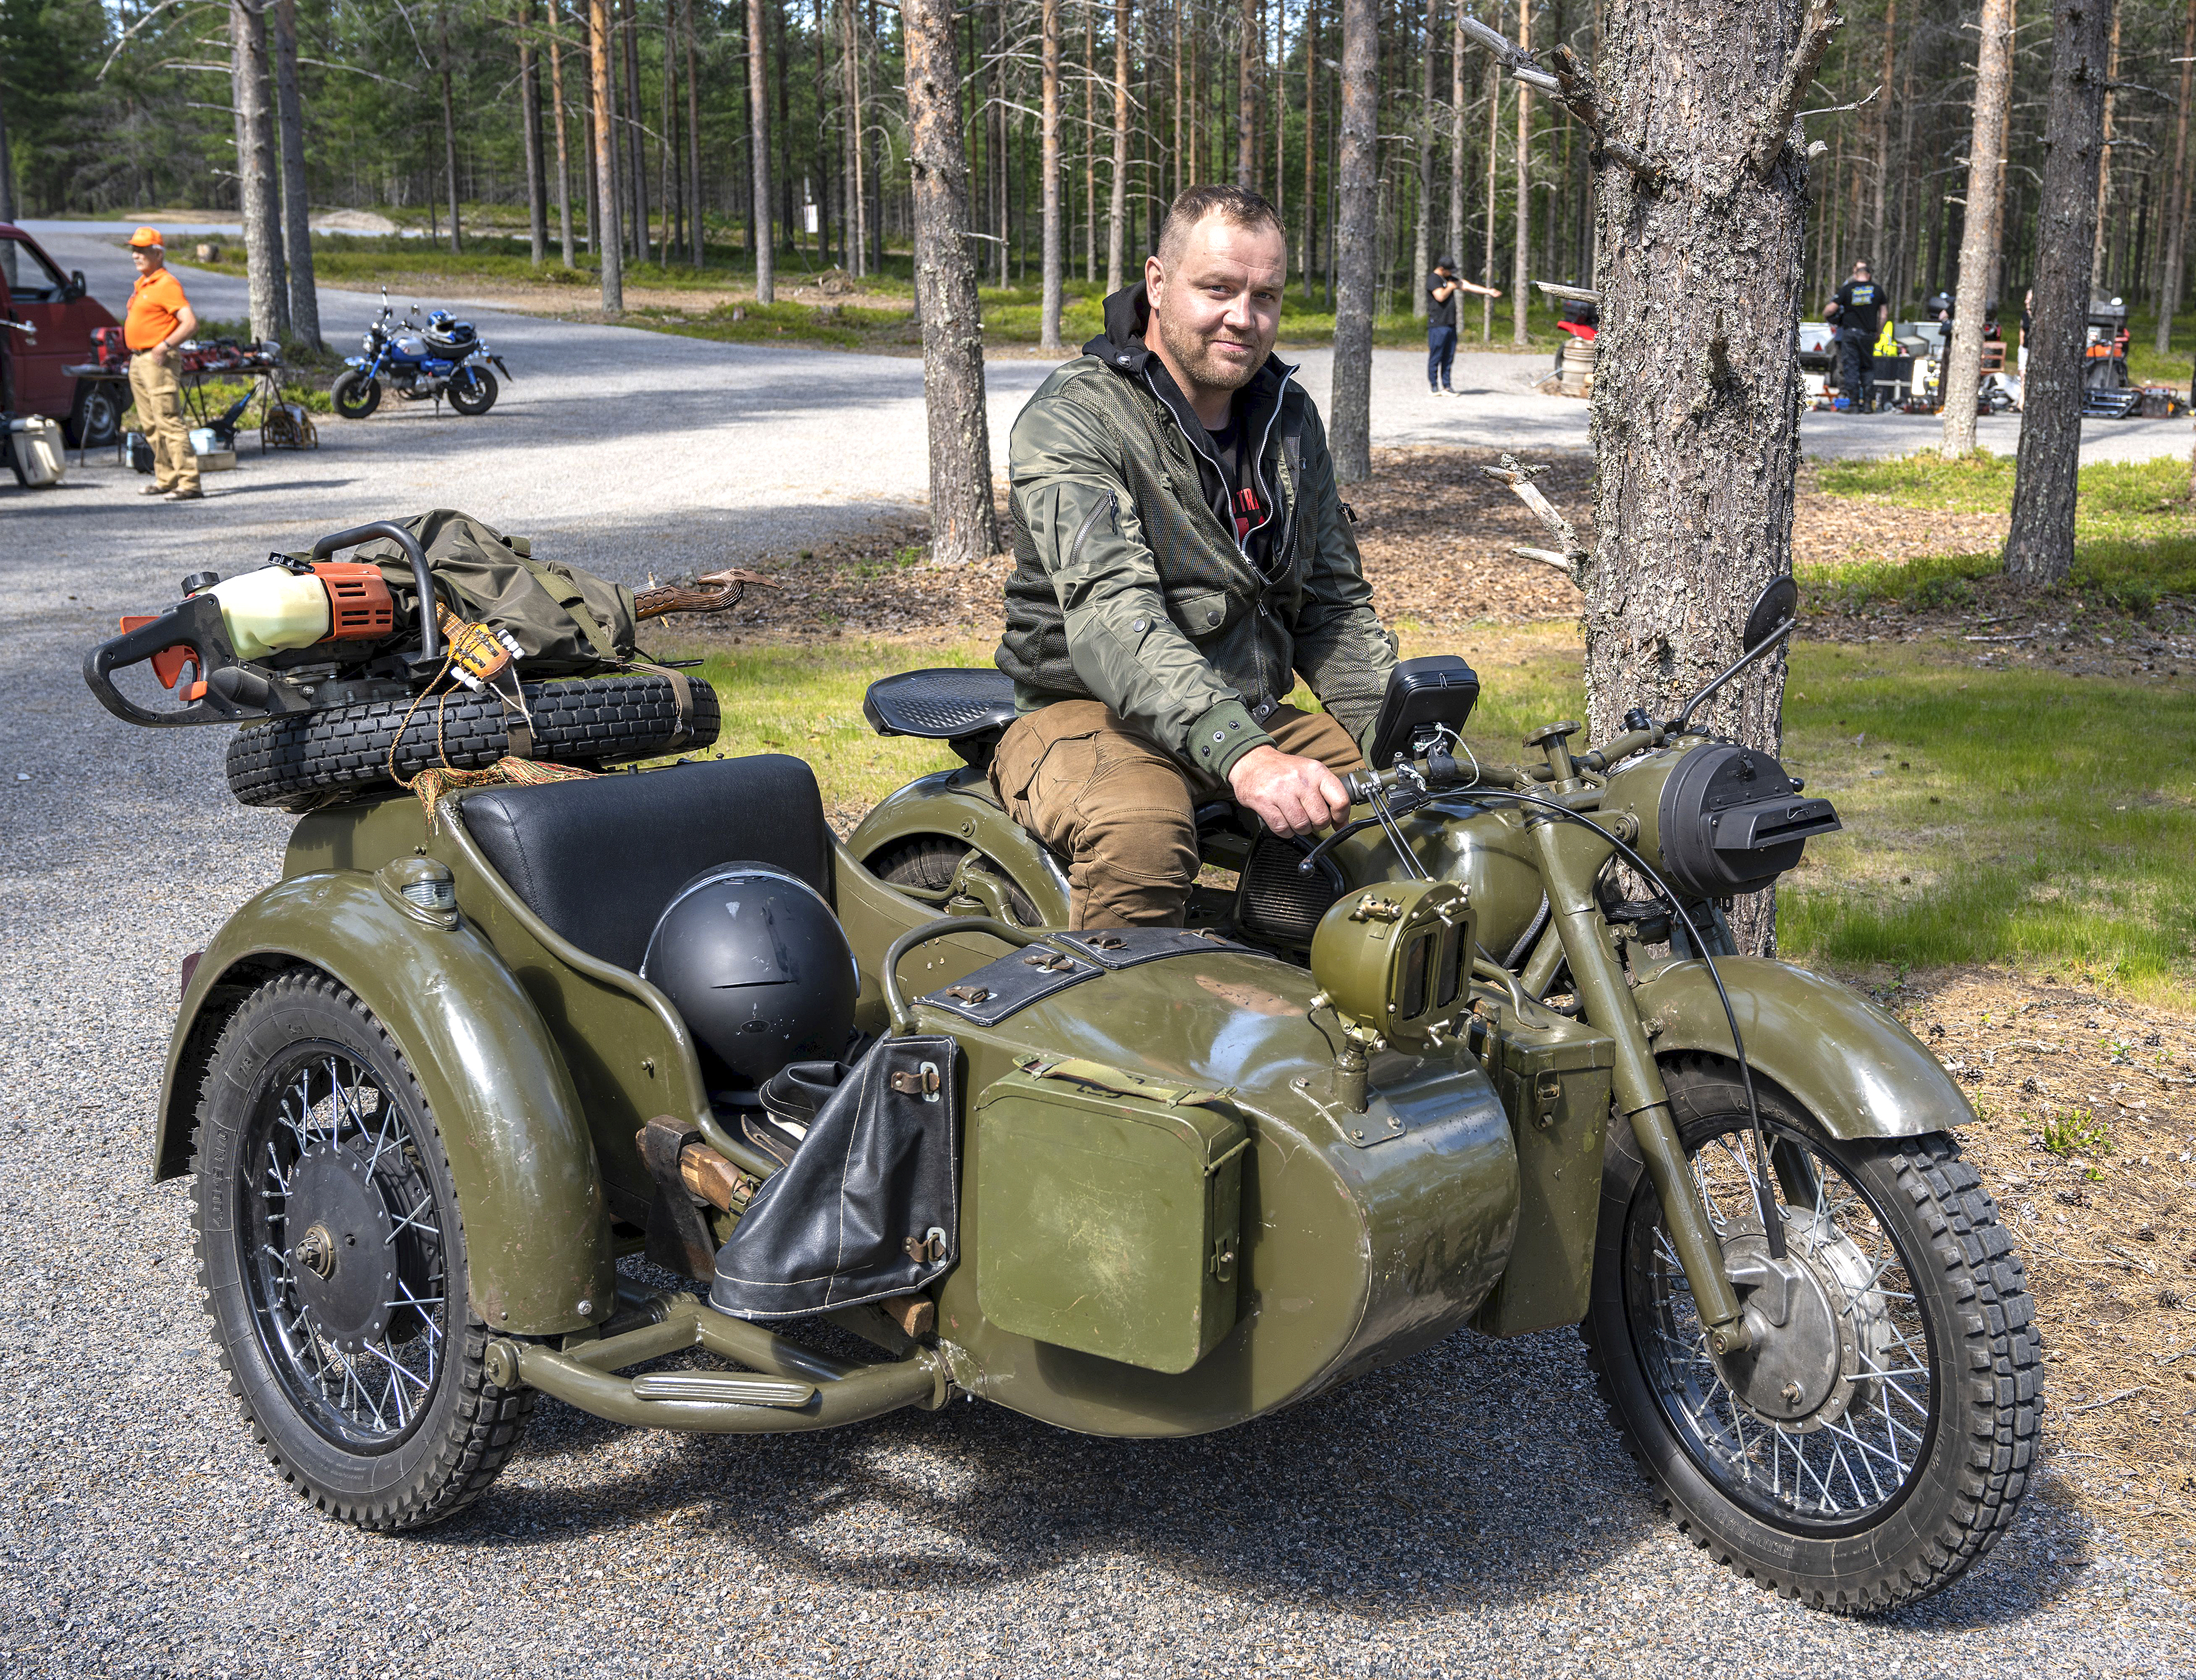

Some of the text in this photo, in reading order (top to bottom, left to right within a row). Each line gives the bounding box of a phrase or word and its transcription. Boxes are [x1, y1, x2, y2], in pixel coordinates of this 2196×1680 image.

[211, 1128, 229, 1228] 4.00-19 M/C
[1713, 1509, 1795, 1559] HEIDENAU
